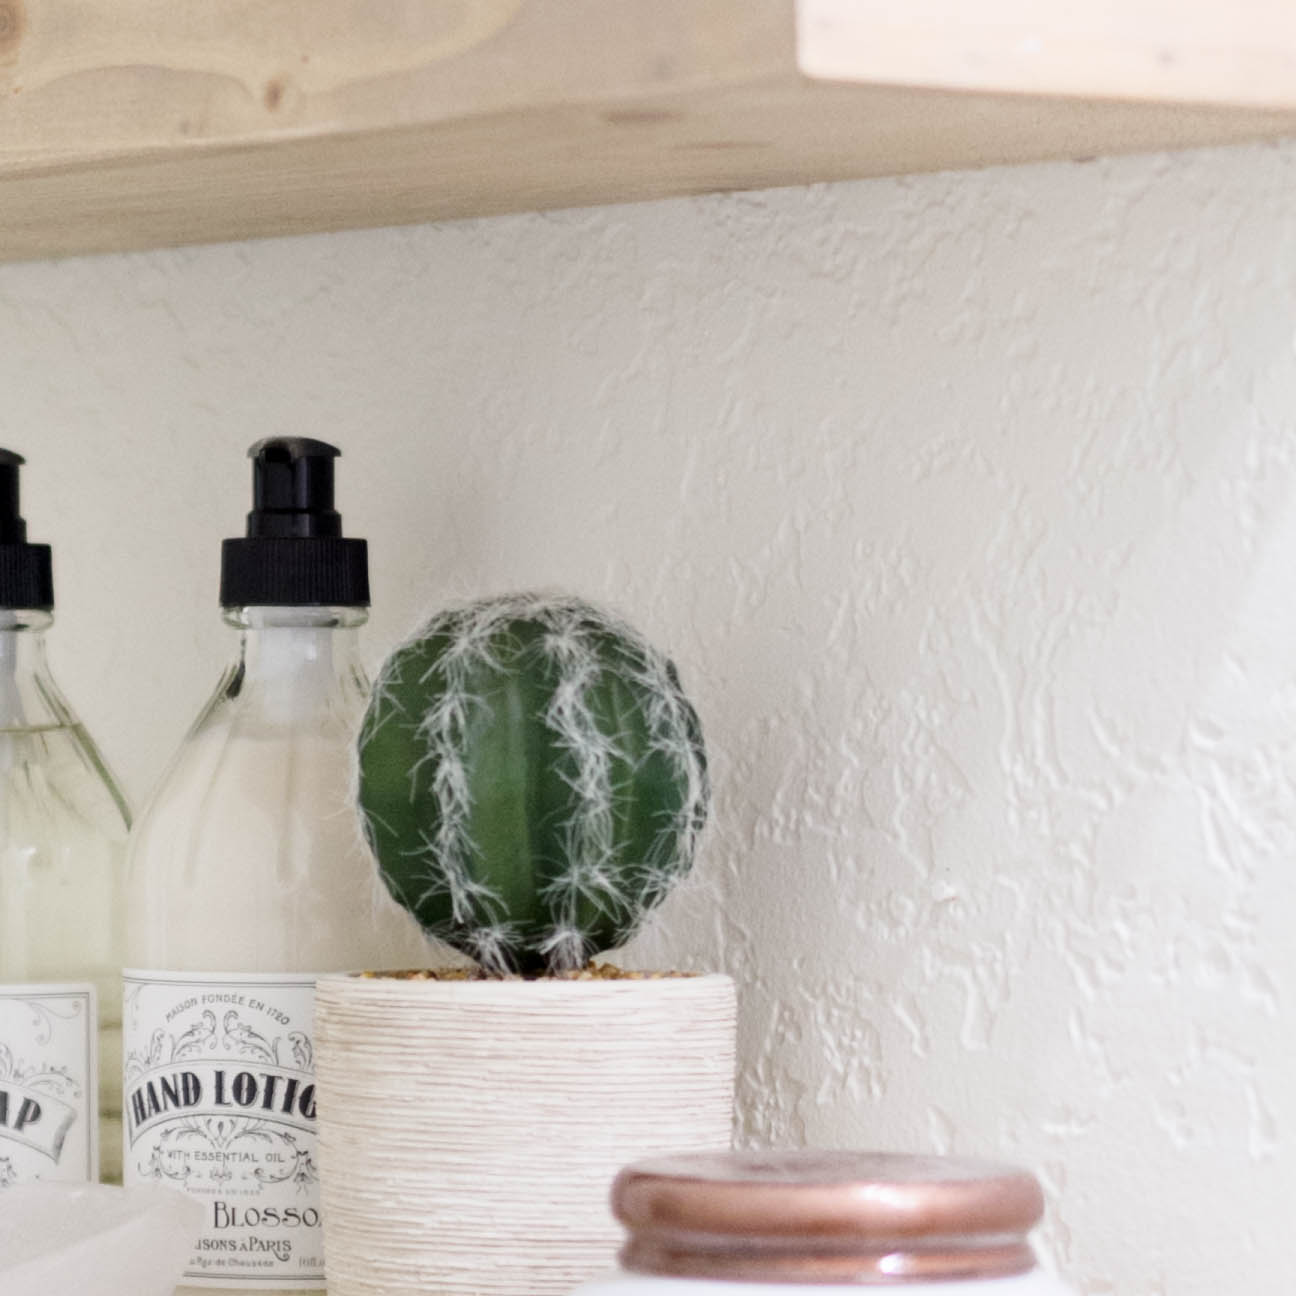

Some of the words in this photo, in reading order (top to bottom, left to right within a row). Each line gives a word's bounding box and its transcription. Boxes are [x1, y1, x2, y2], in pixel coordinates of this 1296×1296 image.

[165, 997, 198, 1023] MAISON
[248, 999, 265, 1012] EN
[131, 1070, 203, 1127] HAND
[194, 1151, 259, 1163] ESSENTIAL
[265, 1152, 286, 1163] OIL
[249, 1236, 293, 1262] PARIS
